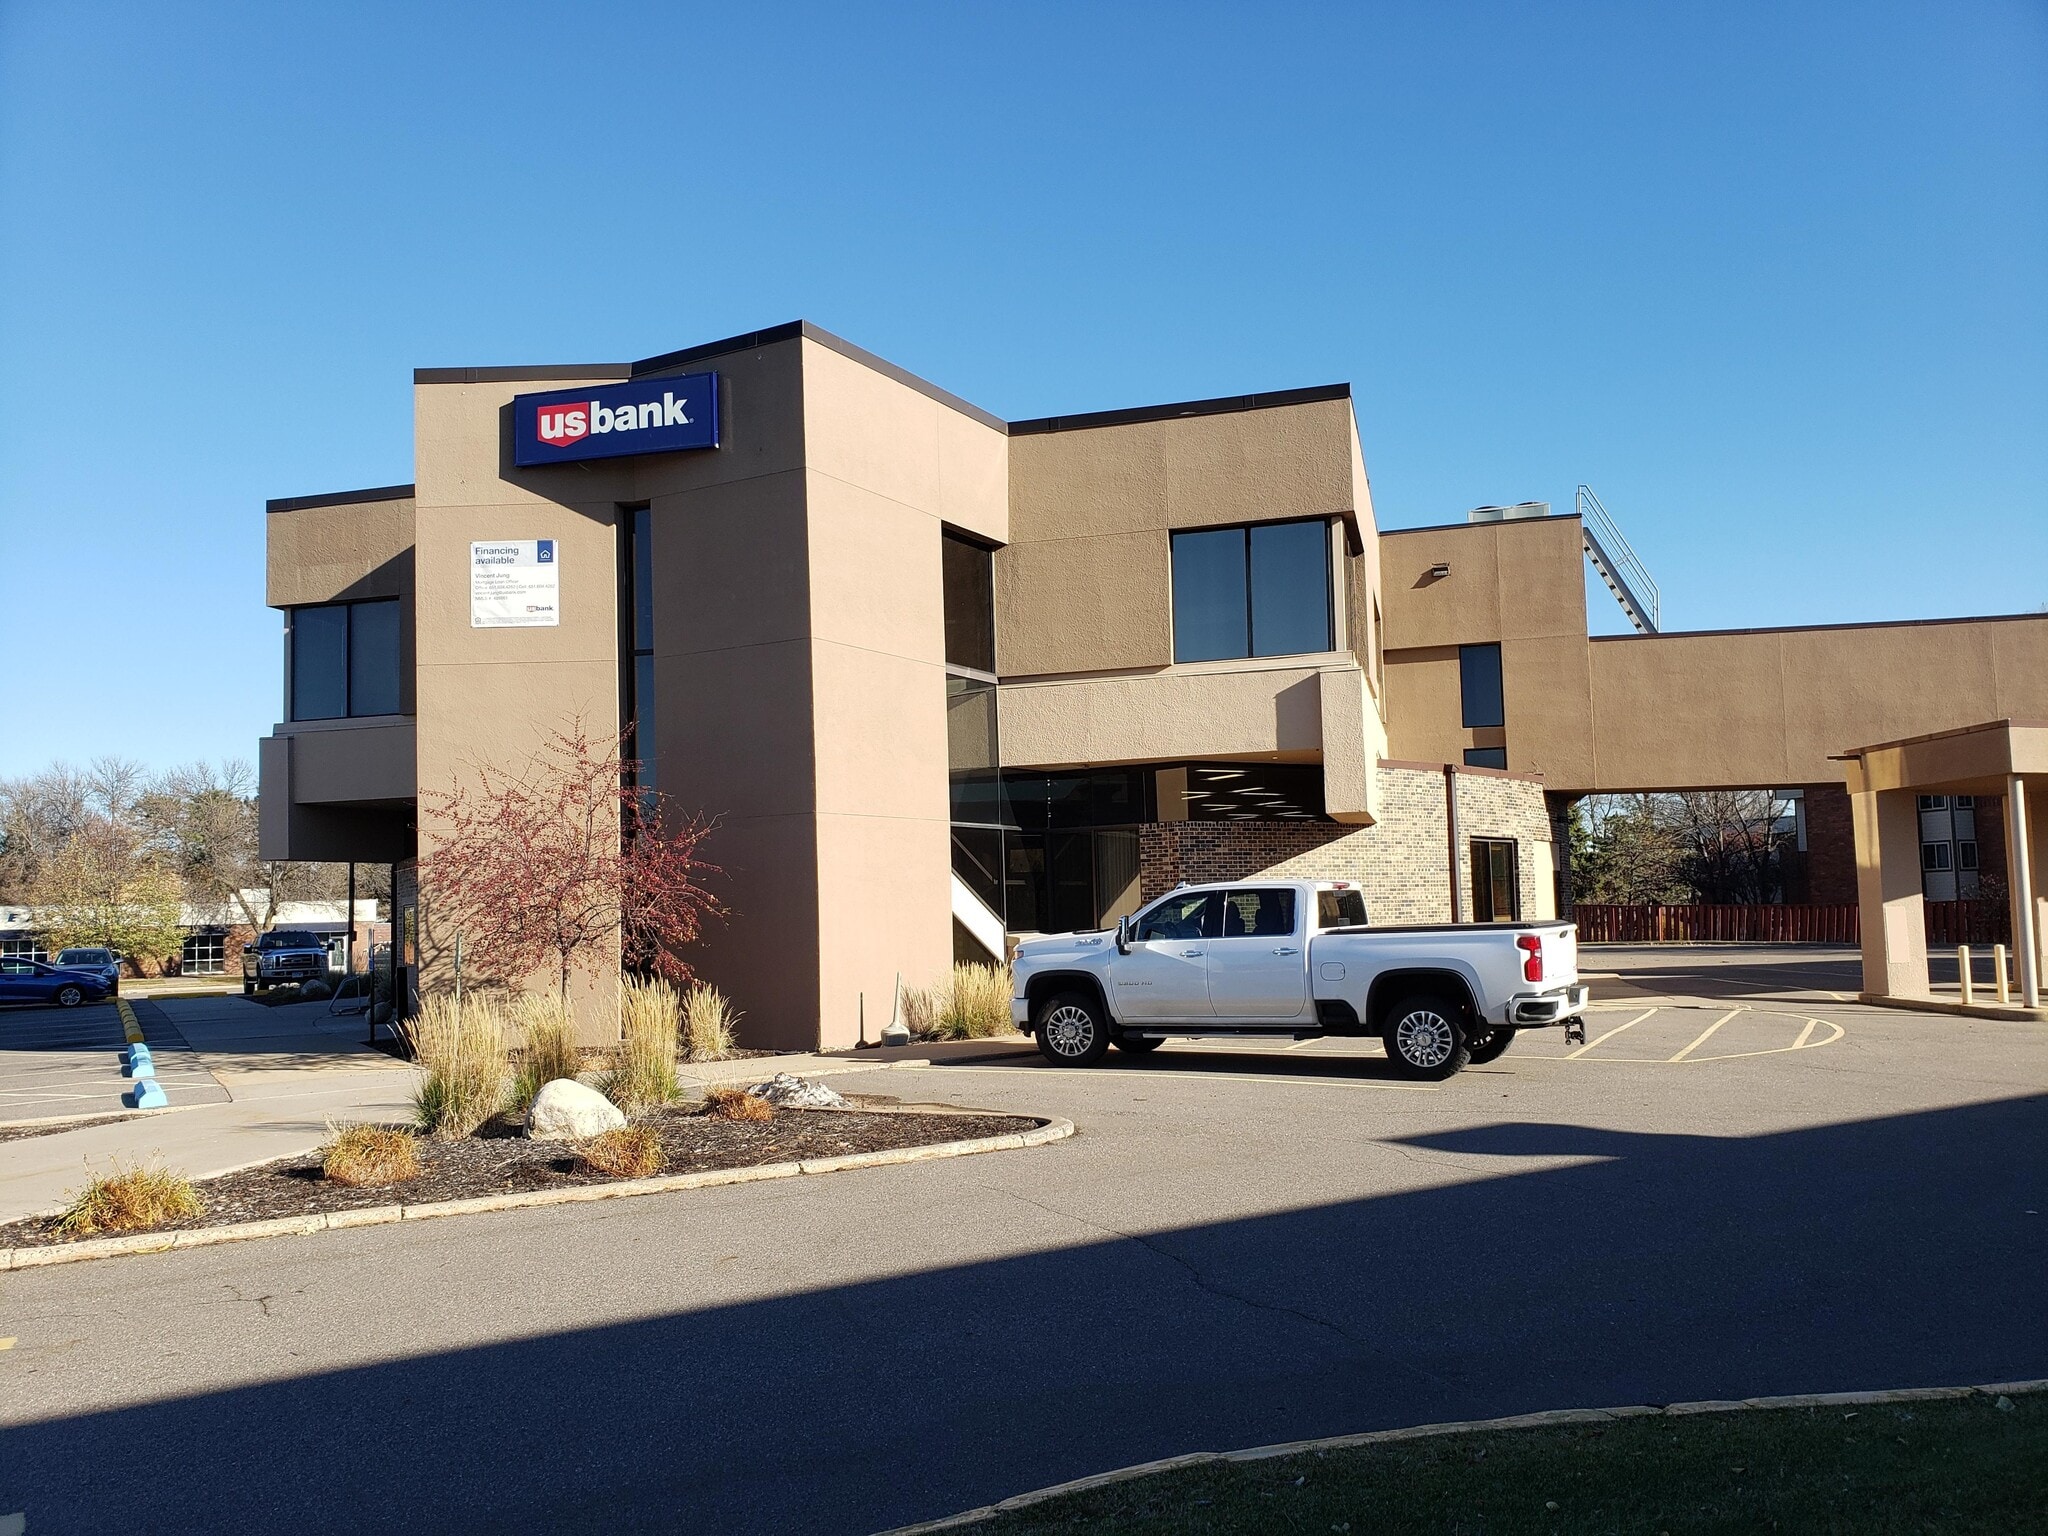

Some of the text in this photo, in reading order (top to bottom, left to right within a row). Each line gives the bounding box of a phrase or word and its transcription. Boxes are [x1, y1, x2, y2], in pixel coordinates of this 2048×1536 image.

[540, 392, 690, 440] usbank
[475, 546, 519, 556] Financing
[475, 556, 515, 565] available
